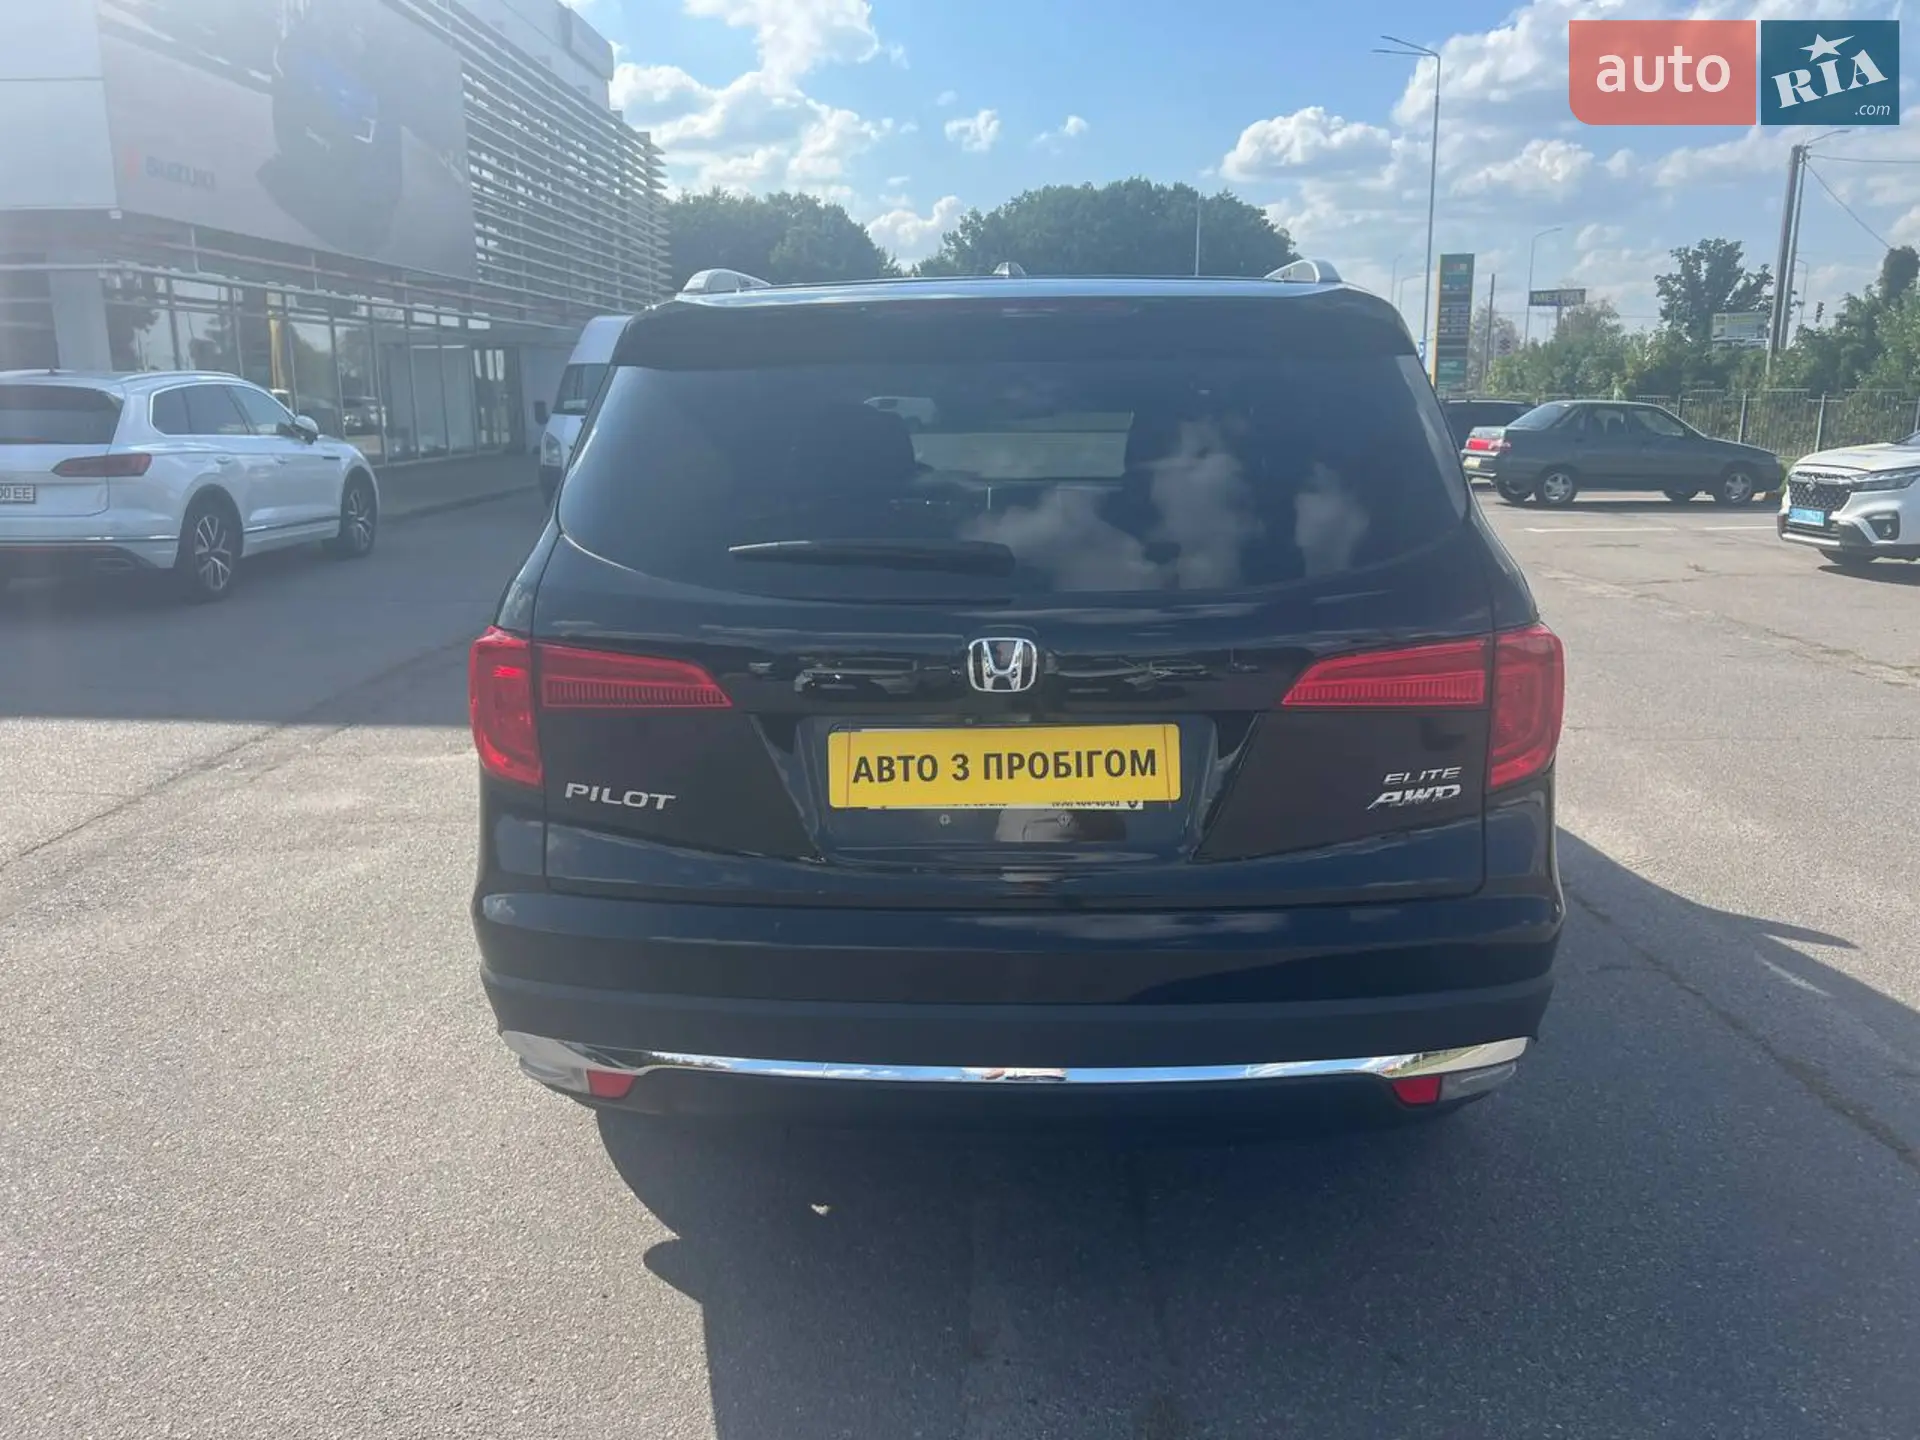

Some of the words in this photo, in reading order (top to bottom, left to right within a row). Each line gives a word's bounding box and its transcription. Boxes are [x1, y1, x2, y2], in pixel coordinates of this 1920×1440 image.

[852, 754, 939, 784] АВТО
[983, 748, 1157, 780] ПРОБІГОМ
[1383, 766, 1463, 786] ELITE
[564, 782, 677, 811] PILOT
[1367, 783, 1462, 810] AWD
